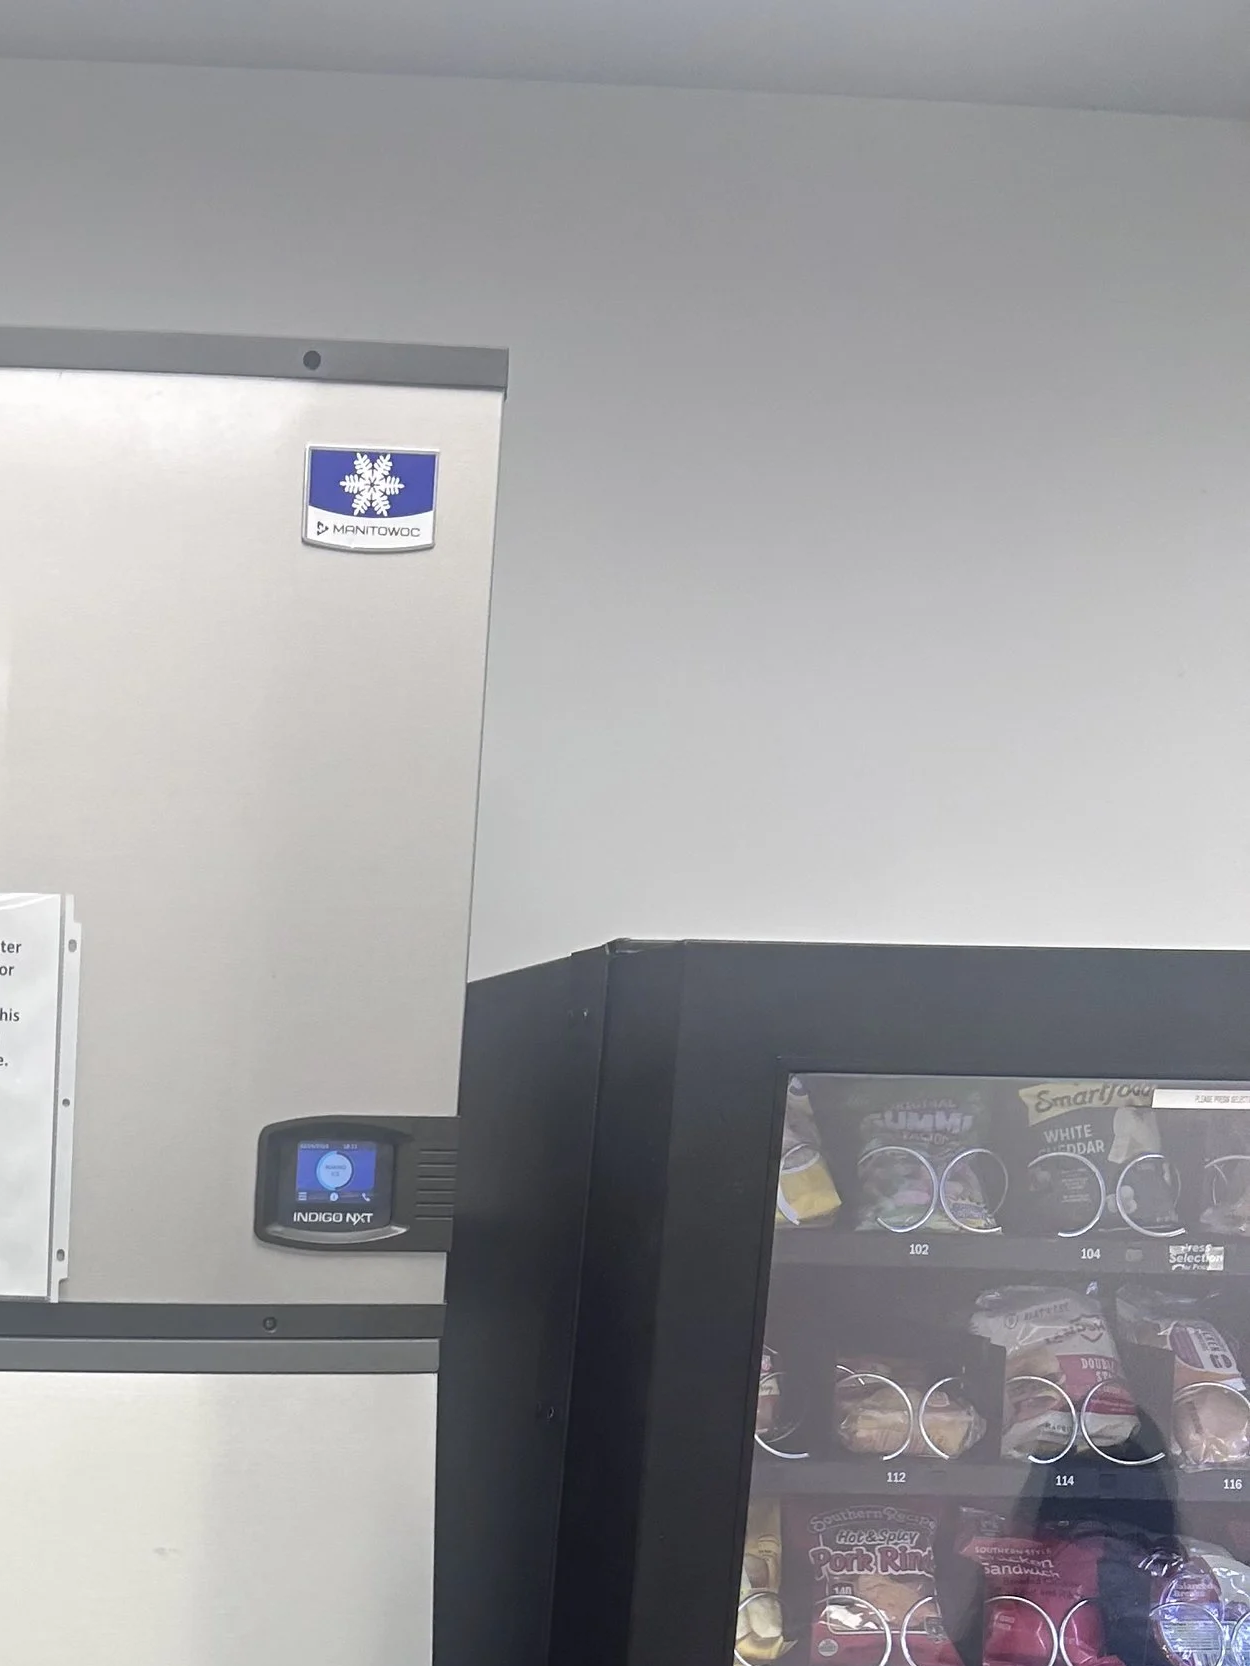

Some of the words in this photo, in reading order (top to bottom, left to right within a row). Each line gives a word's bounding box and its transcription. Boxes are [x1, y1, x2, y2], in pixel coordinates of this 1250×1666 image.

[332, 525, 421, 538] MANITOWOC
[1043, 1124, 1093, 1144] WHITE
[293, 1212, 343, 1223] INDIGO
[346, 1213, 373, 1225] NXT
[909, 1244, 929, 1255] 102
[1081, 1248, 1101, 1259] 104
[887, 1472, 906, 1483] 112
[1056, 1475, 1075, 1487] 114
[1223, 1478, 1243, 1490] 116
[809, 1547, 876, 1581] Pork
